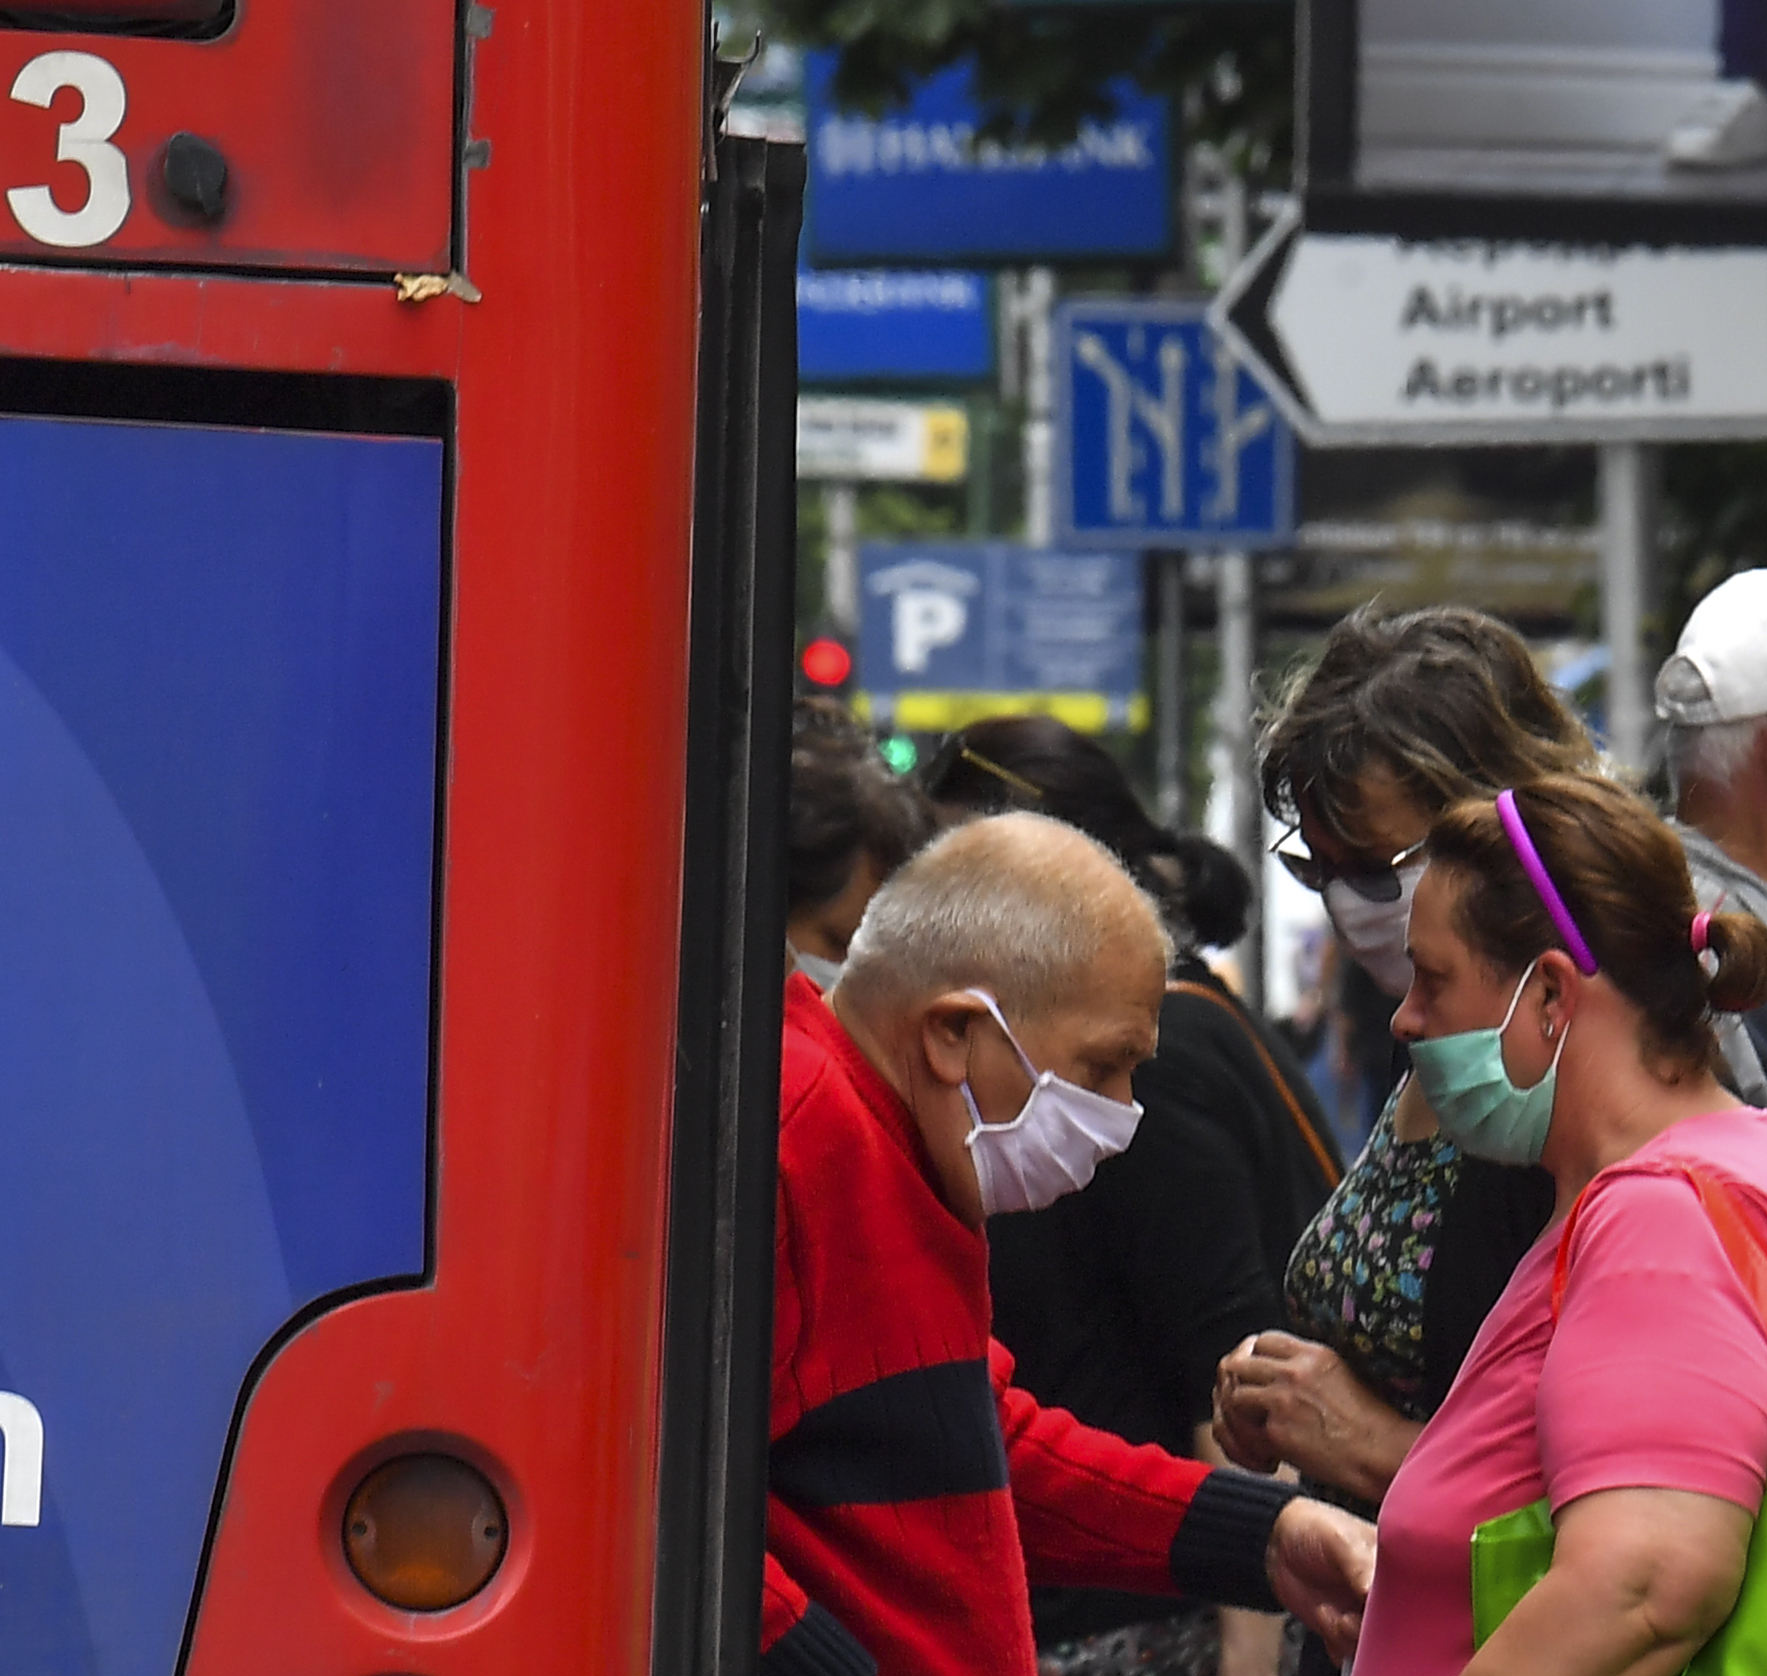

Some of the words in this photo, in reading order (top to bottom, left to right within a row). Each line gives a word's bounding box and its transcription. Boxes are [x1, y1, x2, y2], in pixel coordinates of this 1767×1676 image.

[6, 50, 131, 248] 3
[1402, 284, 1614, 342] Airport
[1402, 354, 1692, 408] Aeroporti
[893, 591, 967, 673] P
